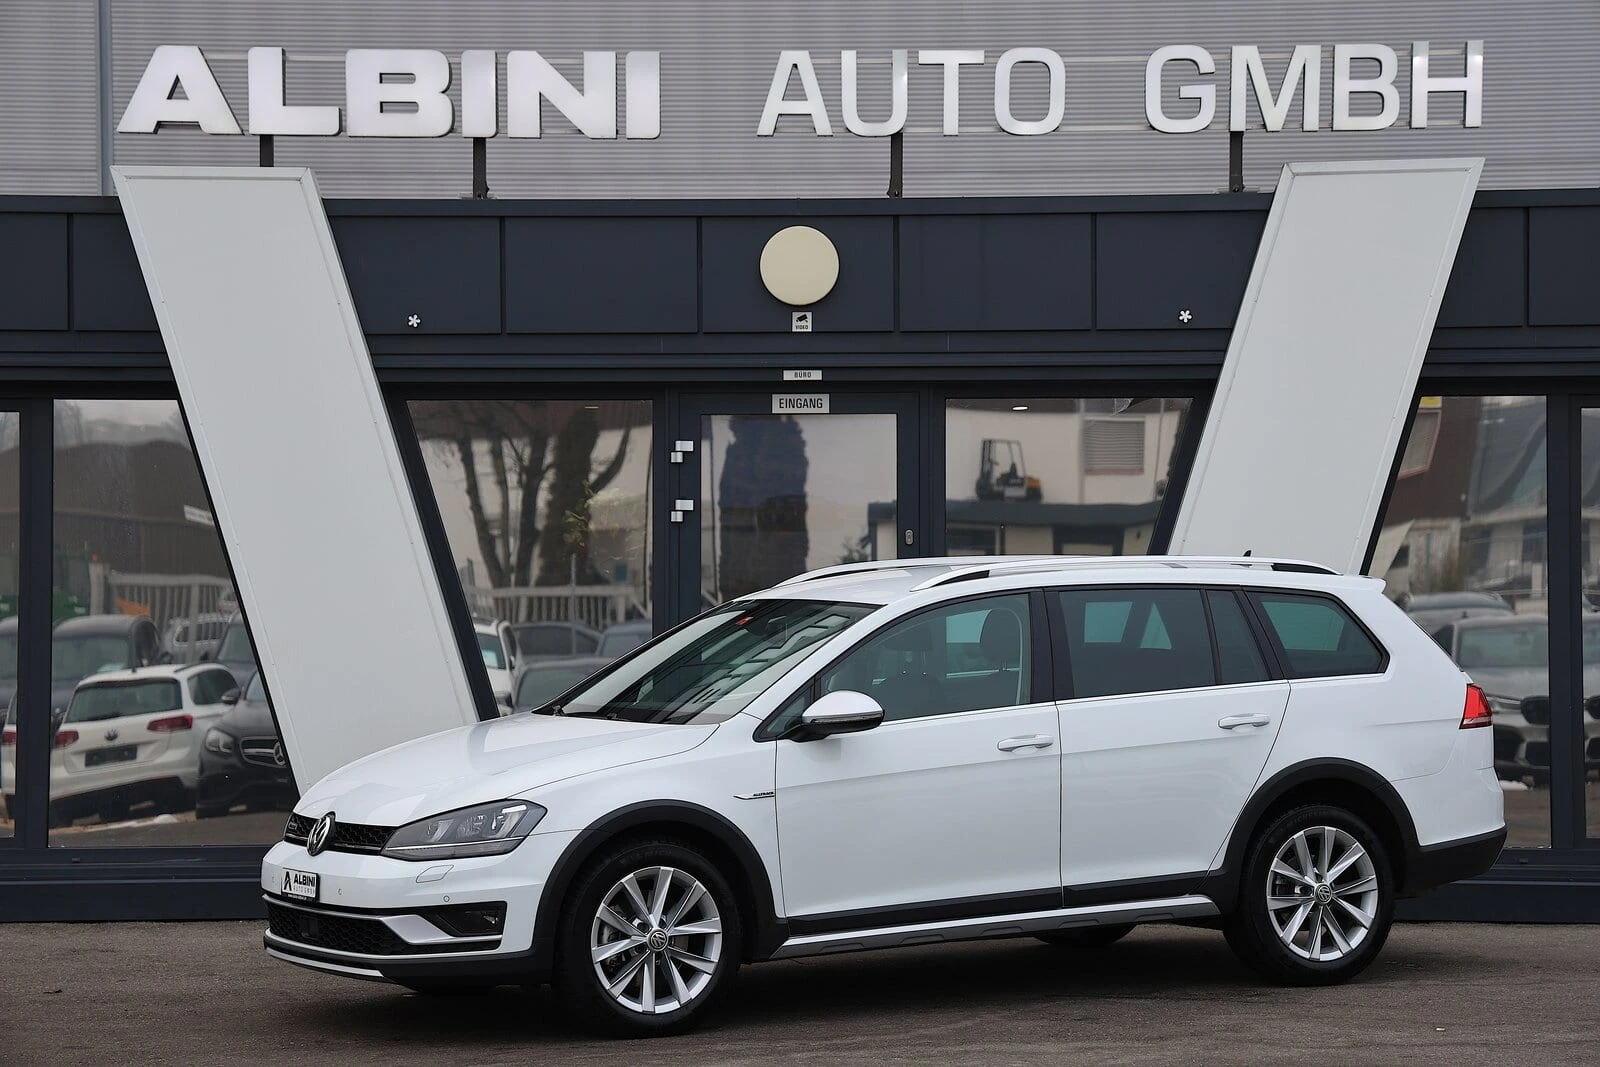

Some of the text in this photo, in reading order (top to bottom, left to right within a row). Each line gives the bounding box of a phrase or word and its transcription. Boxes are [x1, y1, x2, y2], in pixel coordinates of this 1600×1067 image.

[116, 40, 1485, 140] ALBINI AUTO GMBH
[778, 397, 823, 409] EINGANG
[293, 873, 316, 888] ALBINI
